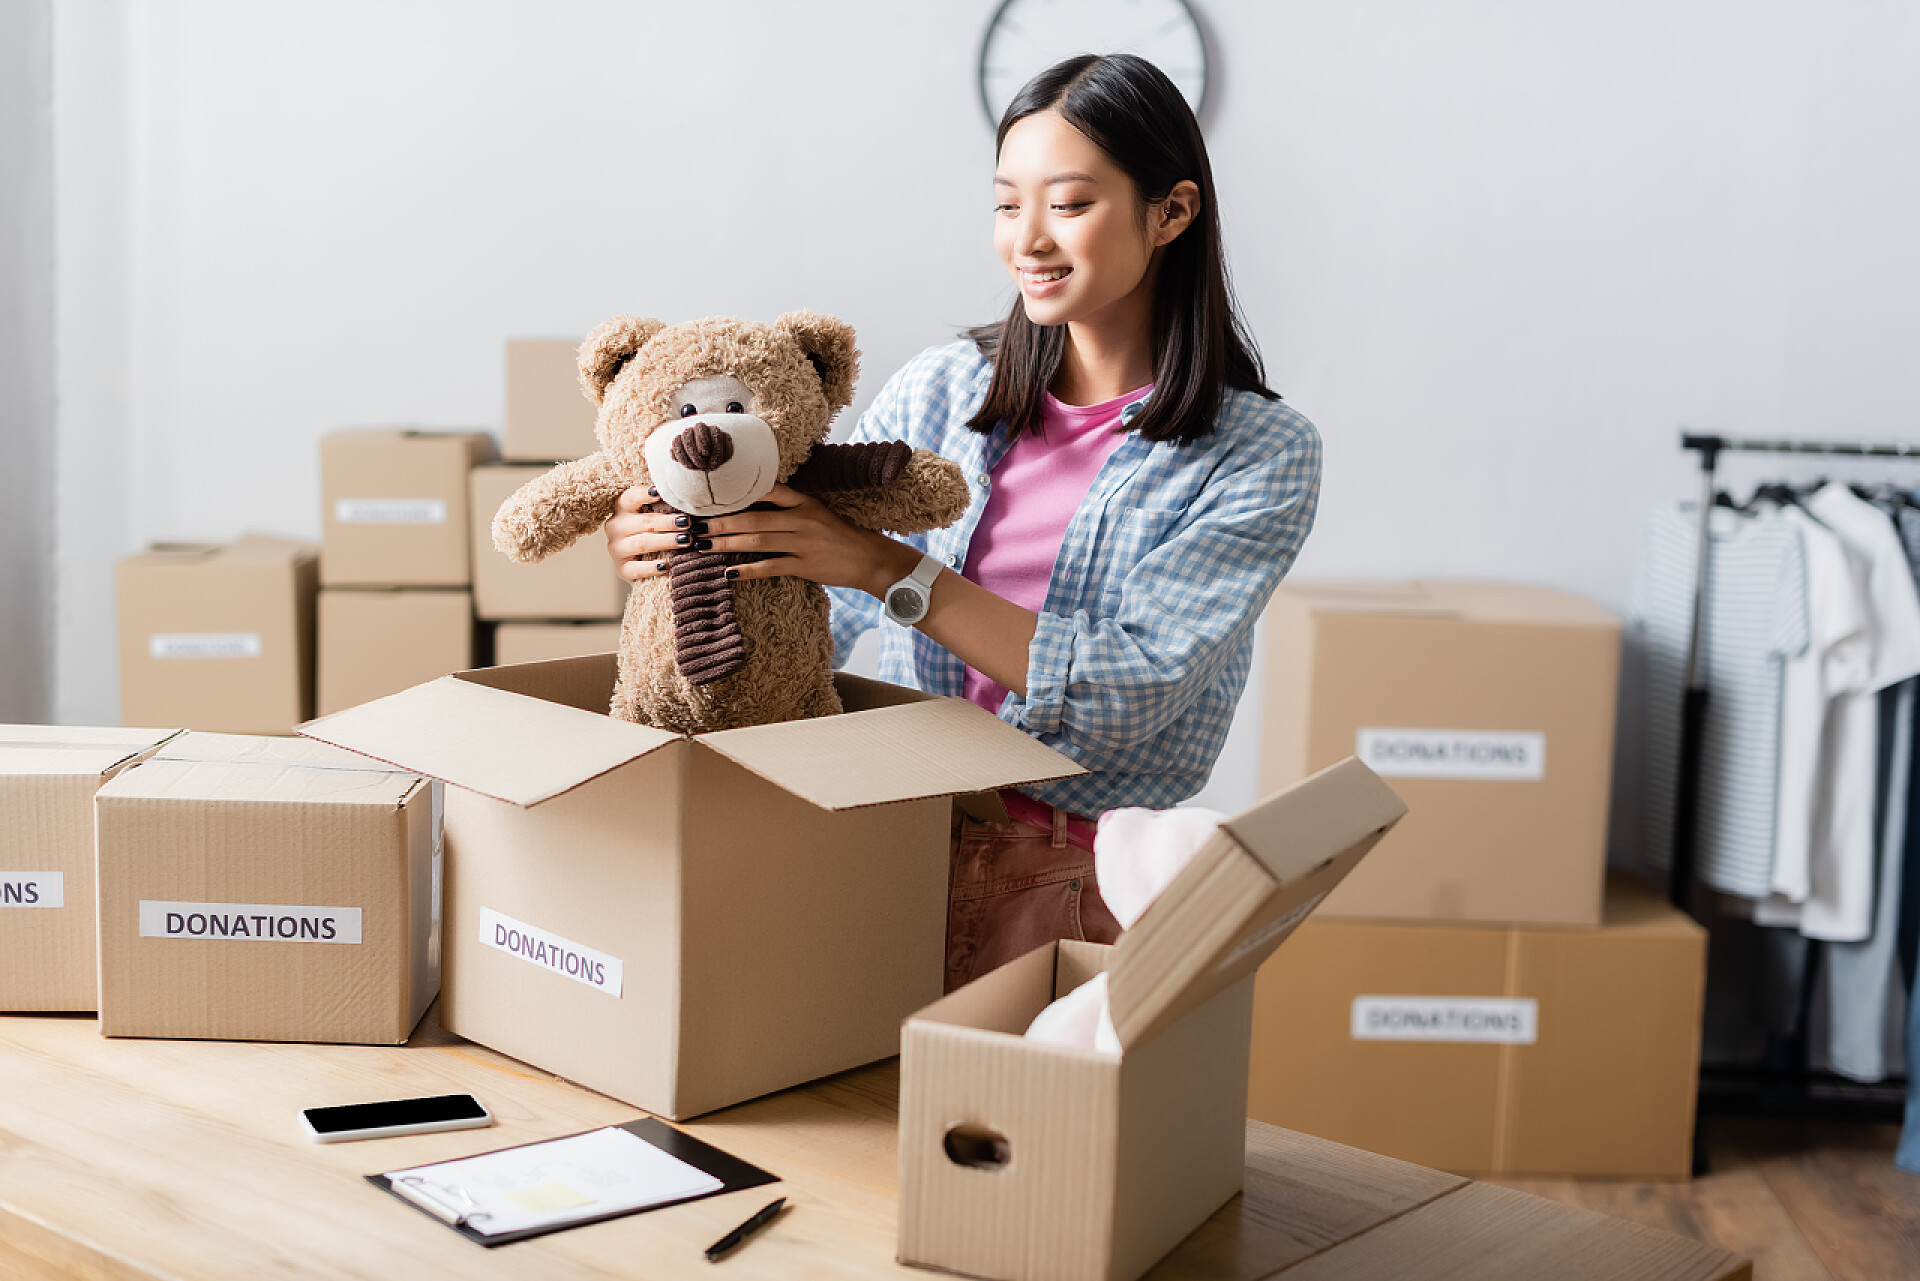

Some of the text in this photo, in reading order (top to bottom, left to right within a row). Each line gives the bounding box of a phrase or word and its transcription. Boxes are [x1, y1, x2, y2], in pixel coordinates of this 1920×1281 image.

[1371, 738, 1528, 767] DONATIONS
[0, 882, 39, 904] NS
[166, 912, 337, 940] DONATIONS
[495, 923, 605, 986] DONATIONS
[1367, 1006, 1522, 1034] DONATIONS
